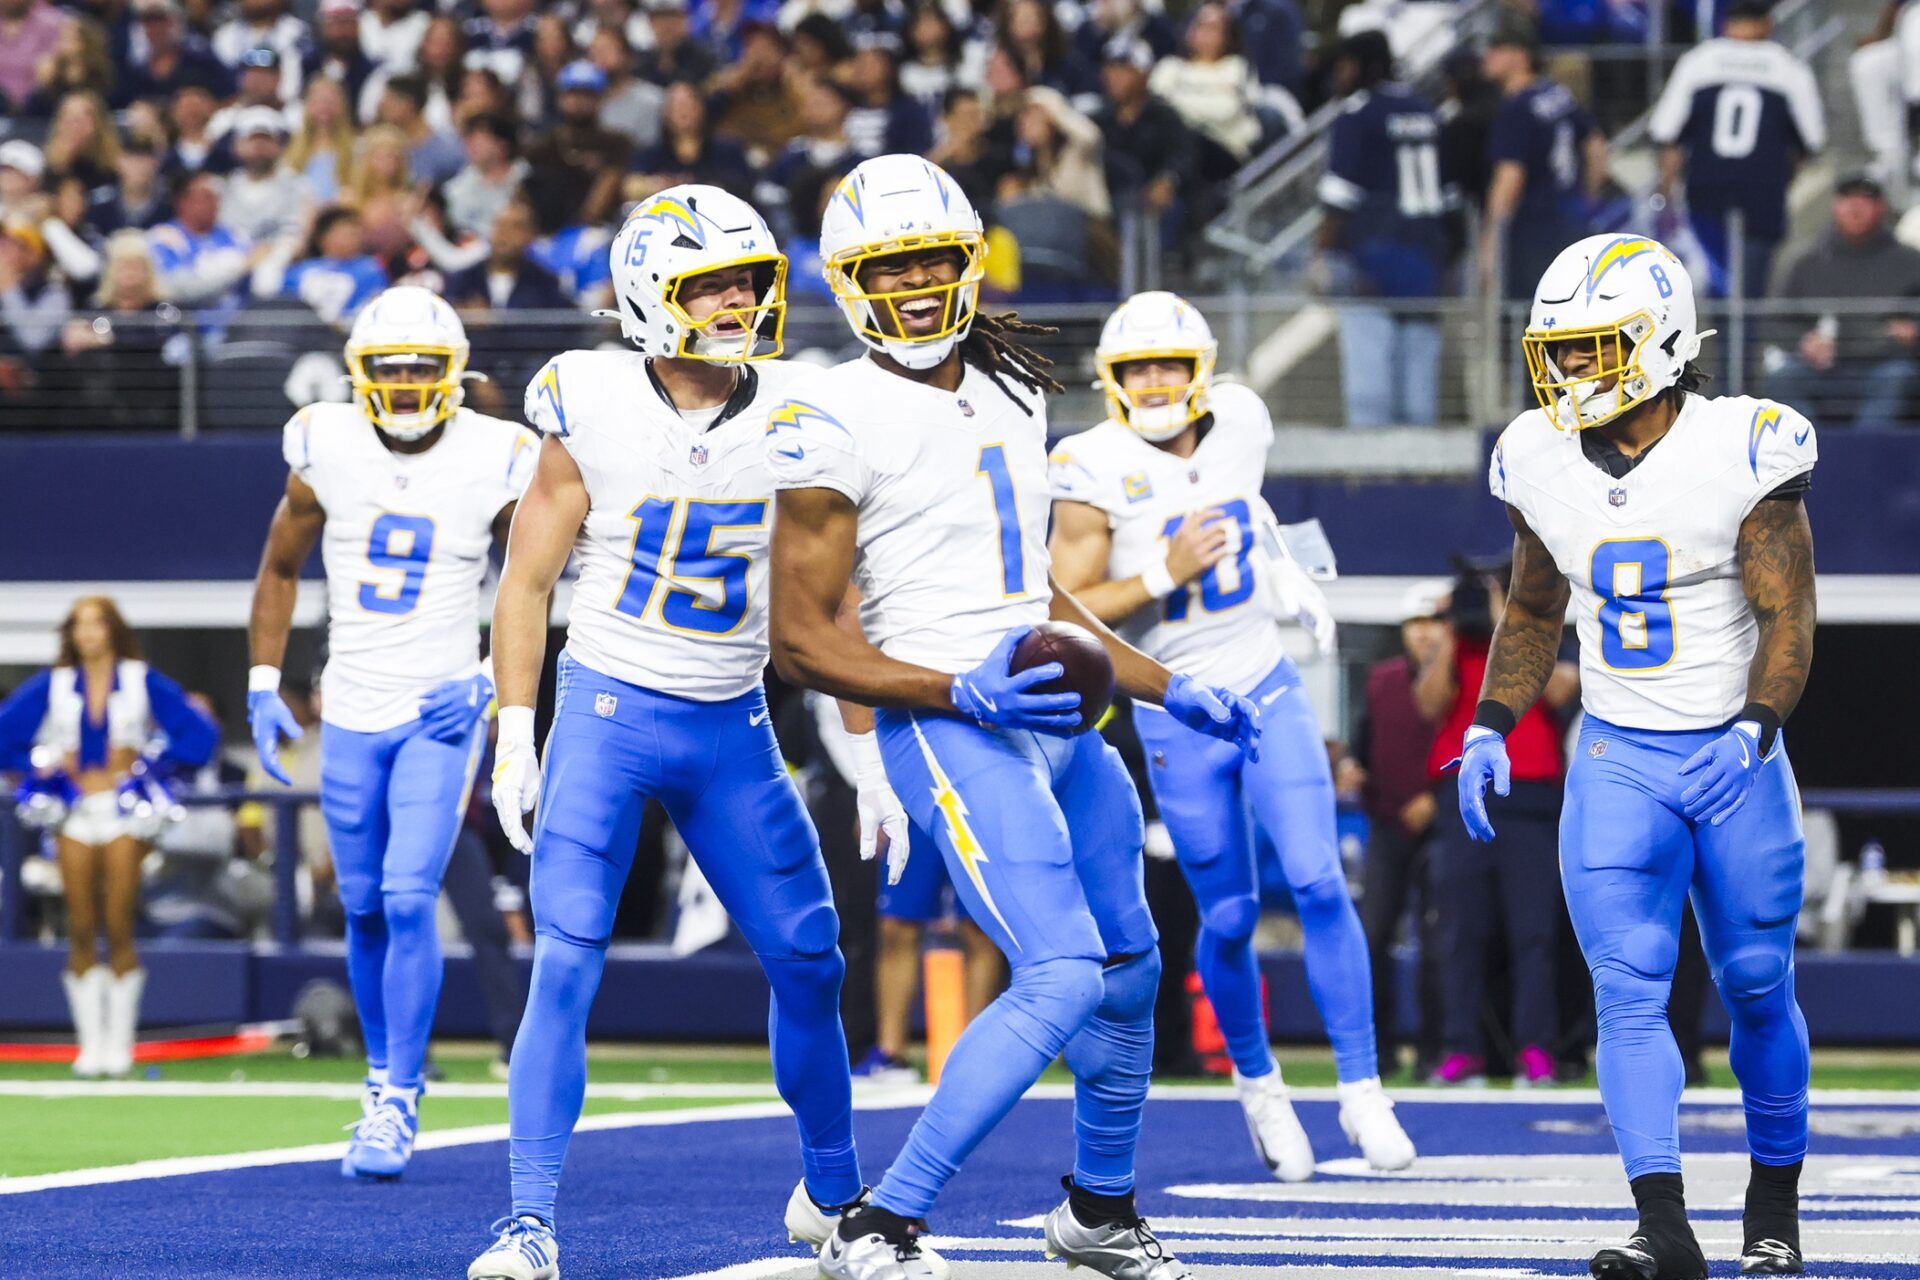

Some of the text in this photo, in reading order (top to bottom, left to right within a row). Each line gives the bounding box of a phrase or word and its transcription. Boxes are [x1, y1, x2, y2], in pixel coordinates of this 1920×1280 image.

[1712, 86, 1763, 158] 0
[624, 230, 653, 266] 15
[741, 239, 756, 250] LA
[1649, 264, 1673, 299] 8
[1543, 317, 1556, 329] LA
[975, 442, 1026, 599] 1
[357, 511, 436, 618] 9
[613, 494, 770, 637] 15
[1588, 535, 1678, 673] 8
